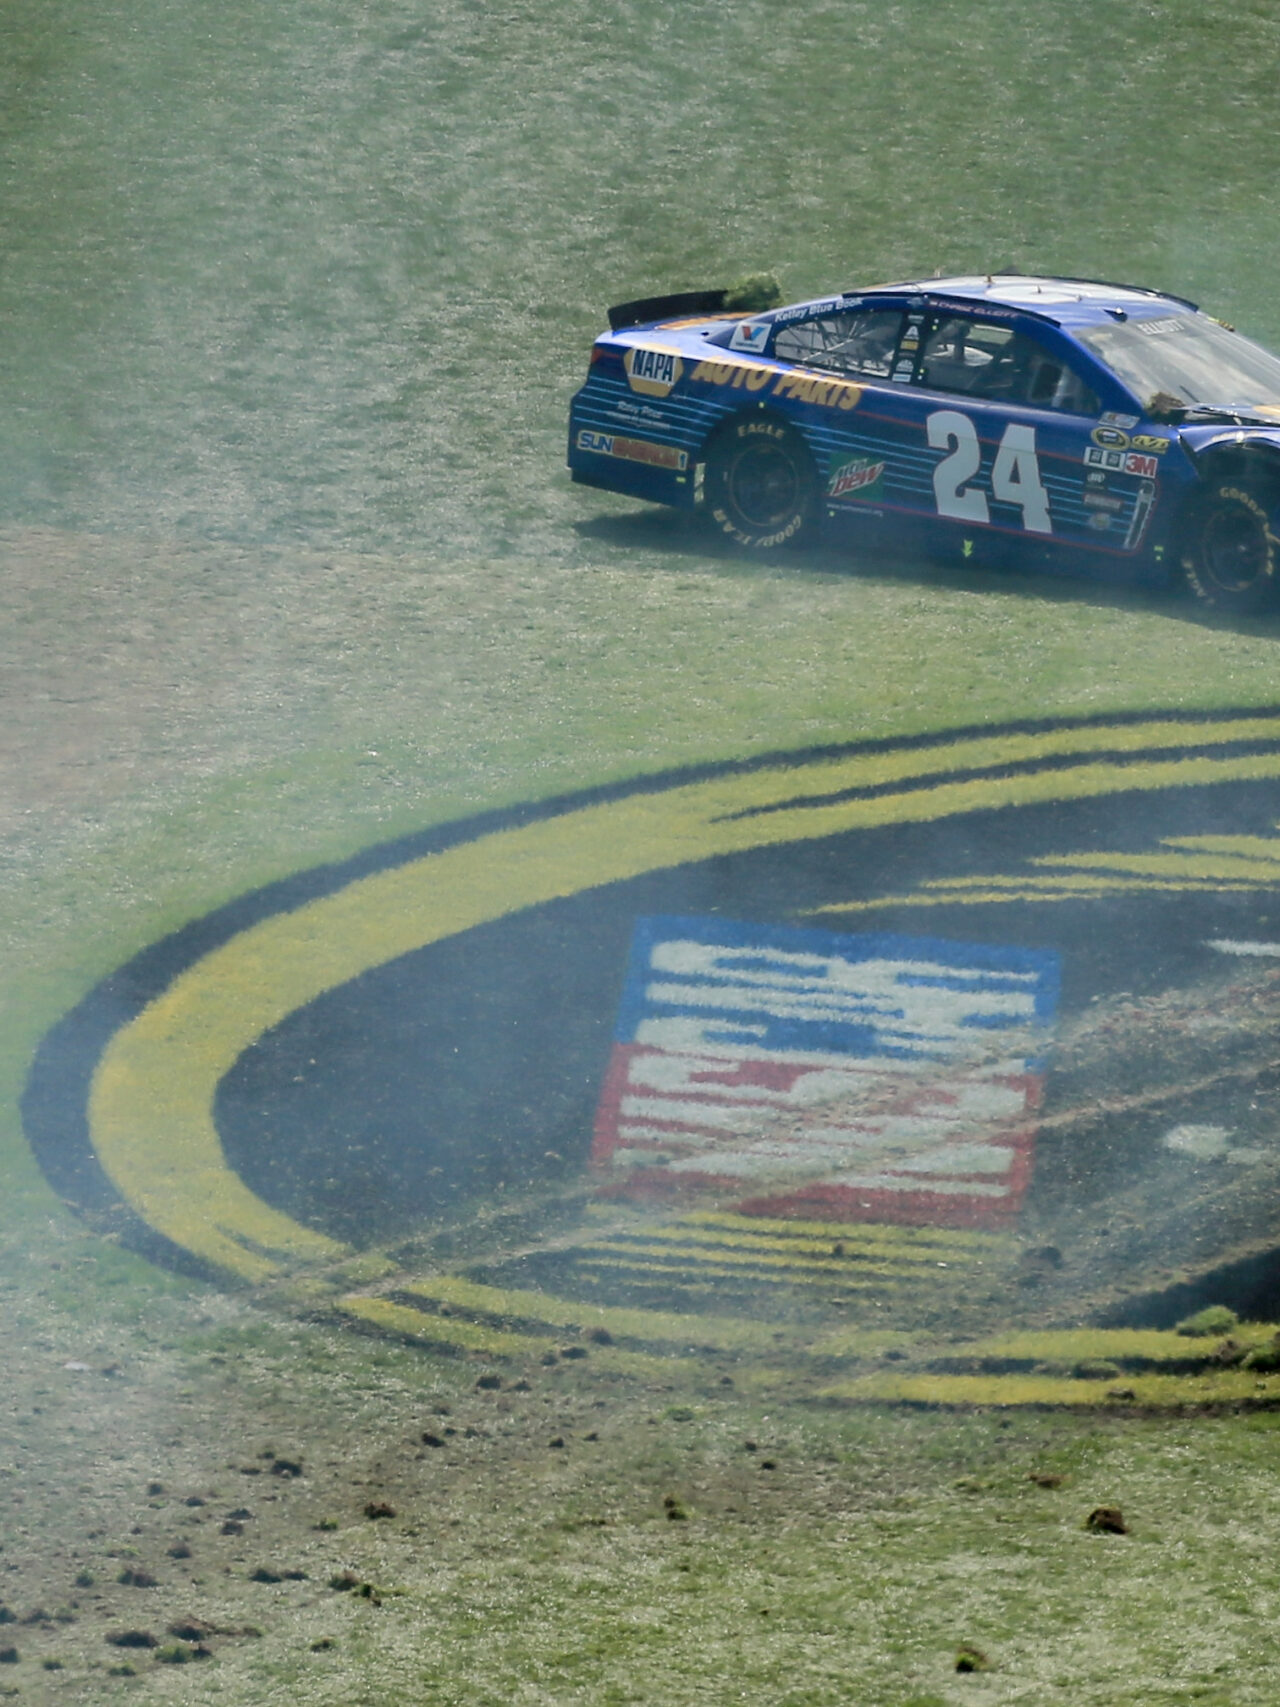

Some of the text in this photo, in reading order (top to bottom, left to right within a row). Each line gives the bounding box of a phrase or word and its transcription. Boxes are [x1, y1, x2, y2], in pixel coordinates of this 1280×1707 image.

[809, 303, 834, 315] Blue
[631, 348, 675, 383] NAPA
[689, 355, 870, 411] AUTO PARTS
[737, 423, 785, 440] EAGLE
[926, 410, 1052, 533] 24
[1124, 454, 1157, 477] 3M
[612, 938, 1040, 1197] NASCAR
